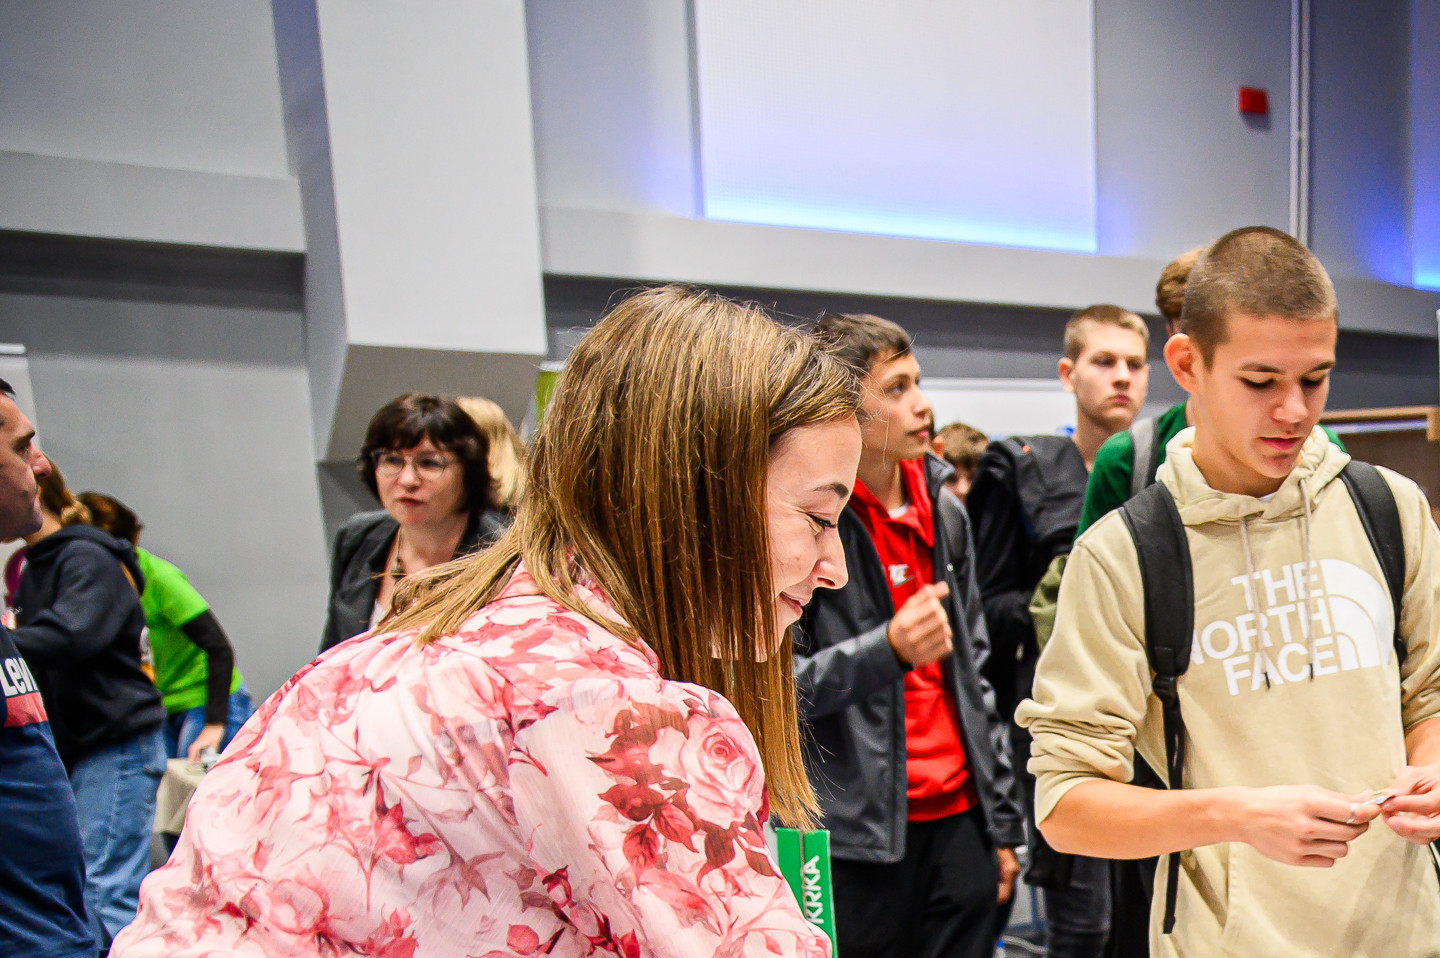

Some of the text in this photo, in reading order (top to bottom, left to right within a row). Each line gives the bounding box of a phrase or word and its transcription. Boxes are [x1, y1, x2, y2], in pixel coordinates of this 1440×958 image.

[1231, 559, 1324, 611] THE
[1222, 636, 1339, 696] FACE
[801, 855, 825, 925] KRKA
